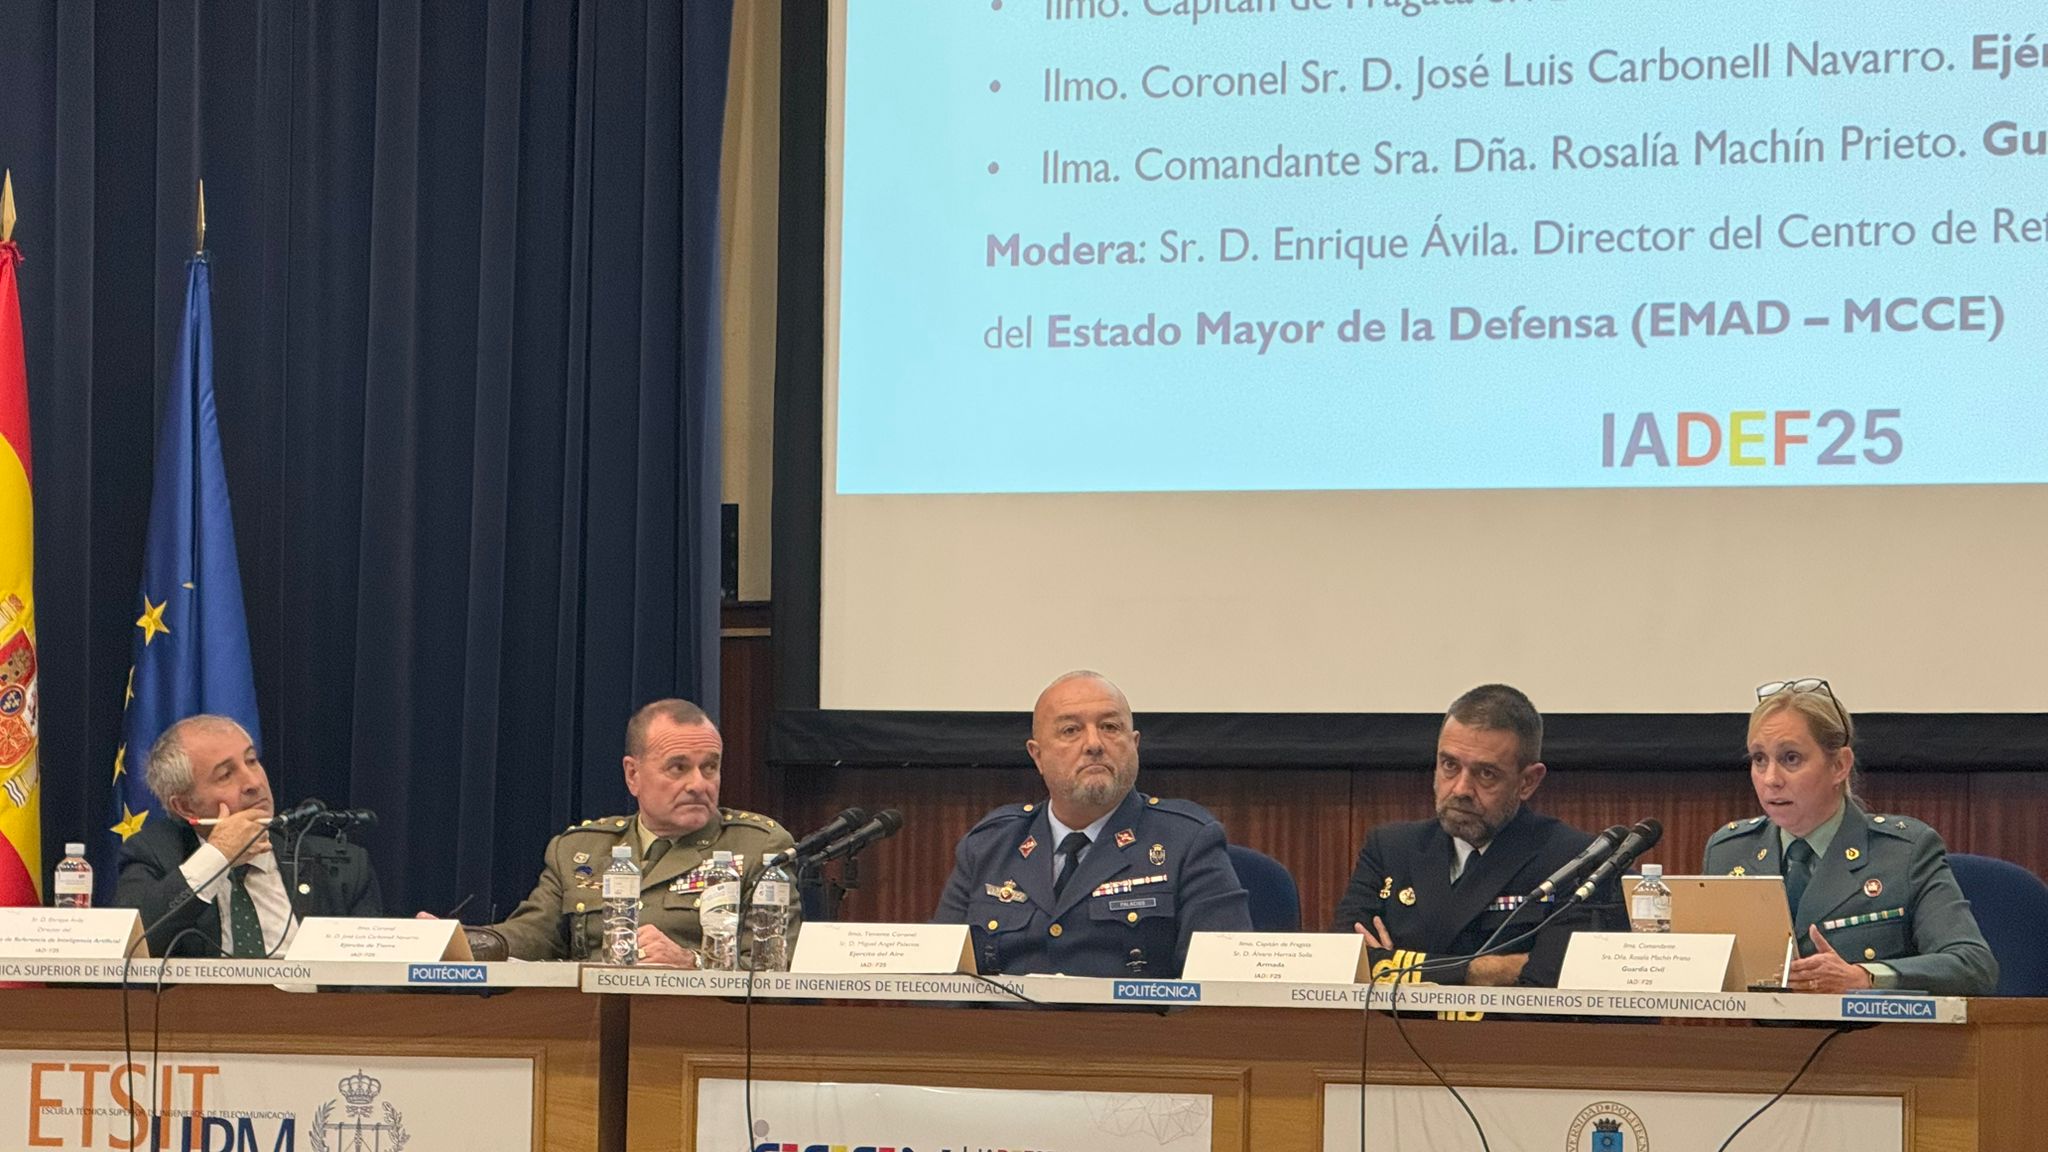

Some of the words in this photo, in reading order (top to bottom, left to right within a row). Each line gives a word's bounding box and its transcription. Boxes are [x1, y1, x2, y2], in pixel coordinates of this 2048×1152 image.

[1045, 68, 1128, 102] Ilmo.
[1141, 61, 1288, 99] Coronel
[1300, 60, 1347, 94] Sr.
[1363, 57, 1402, 92] D.
[1412, 53, 1490, 100] José
[1504, 52, 1574, 87] Luis
[1588, 42, 1771, 83] Carbonell
[1786, 40, 1956, 79] Navarro.
[1043, 150, 1120, 184] Ilma.
[1134, 144, 1361, 182] Comandante
[1373, 141, 1440, 176] Sra.
[1454, 137, 1538, 172] Dña.
[1552, 132, 1680, 169] Rosalía
[1694, 126, 1826, 166] Machín
[1841, 124, 1967, 160] Prieto.
[986, 232, 1147, 268] Modera:
[1159, 230, 1205, 264] Sr.
[1219, 228, 1260, 263] D.
[1274, 226, 1409, 270] Enrique
[1420, 213, 1519, 258] Ávila.
[1533, 219, 1696, 256] Director
[1708, 214, 1762, 249] del
[1777, 212, 1917, 249] Centro
[1931, 208, 1978, 244] de
[983, 315, 1033, 350] del
[1047, 312, 1182, 349] Estado
[1196, 310, 1326, 355] Mayor
[1336, 308, 1387, 344] de
[1400, 307, 1436, 343] la
[1449, 305, 1619, 342] Defensa
[1631, 300, 1792, 349] (EMAD
[1843, 294, 2006, 343] MCCE)
[1601, 407, 1904, 469] IADEF25
[24, 965, 81, 977] SUPERIOR
[85, 965, 99, 977] DE
[176, 966, 191, 977] DE
[195, 964, 311, 978] TELECOMUNICACIÓN
[412, 965, 485, 980] POLITÉCNICA
[597, 974, 651, 987] ESCUELA
[654, 972, 707, 988] TÉCNICA
[710, 976, 771, 990] SUPEROR
[775, 979, 792, 991] DE
[795, 979, 872, 992] INGENIEROS
[875, 980, 892, 992] DE
[895, 980, 1025, 995] TELECOMUNICACIÓN
[1118, 982, 1198, 998] POLITÉCNICA
[1291, 988, 1349, 1002] ESCUELA
[1411, 992, 1476, 1005] SUPERIOR
[1481, 994, 1497, 1005] DE
[1502, 994, 1583, 1008] INGENIEROS
[1587, 996, 1604, 1008] DE
[1608, 996, 1747, 1012] TELECOMUNICACIÓN
[1846, 1001, 1933, 1017] POLITÉCNICA
[28, 1062, 220, 1150] ETSIT
